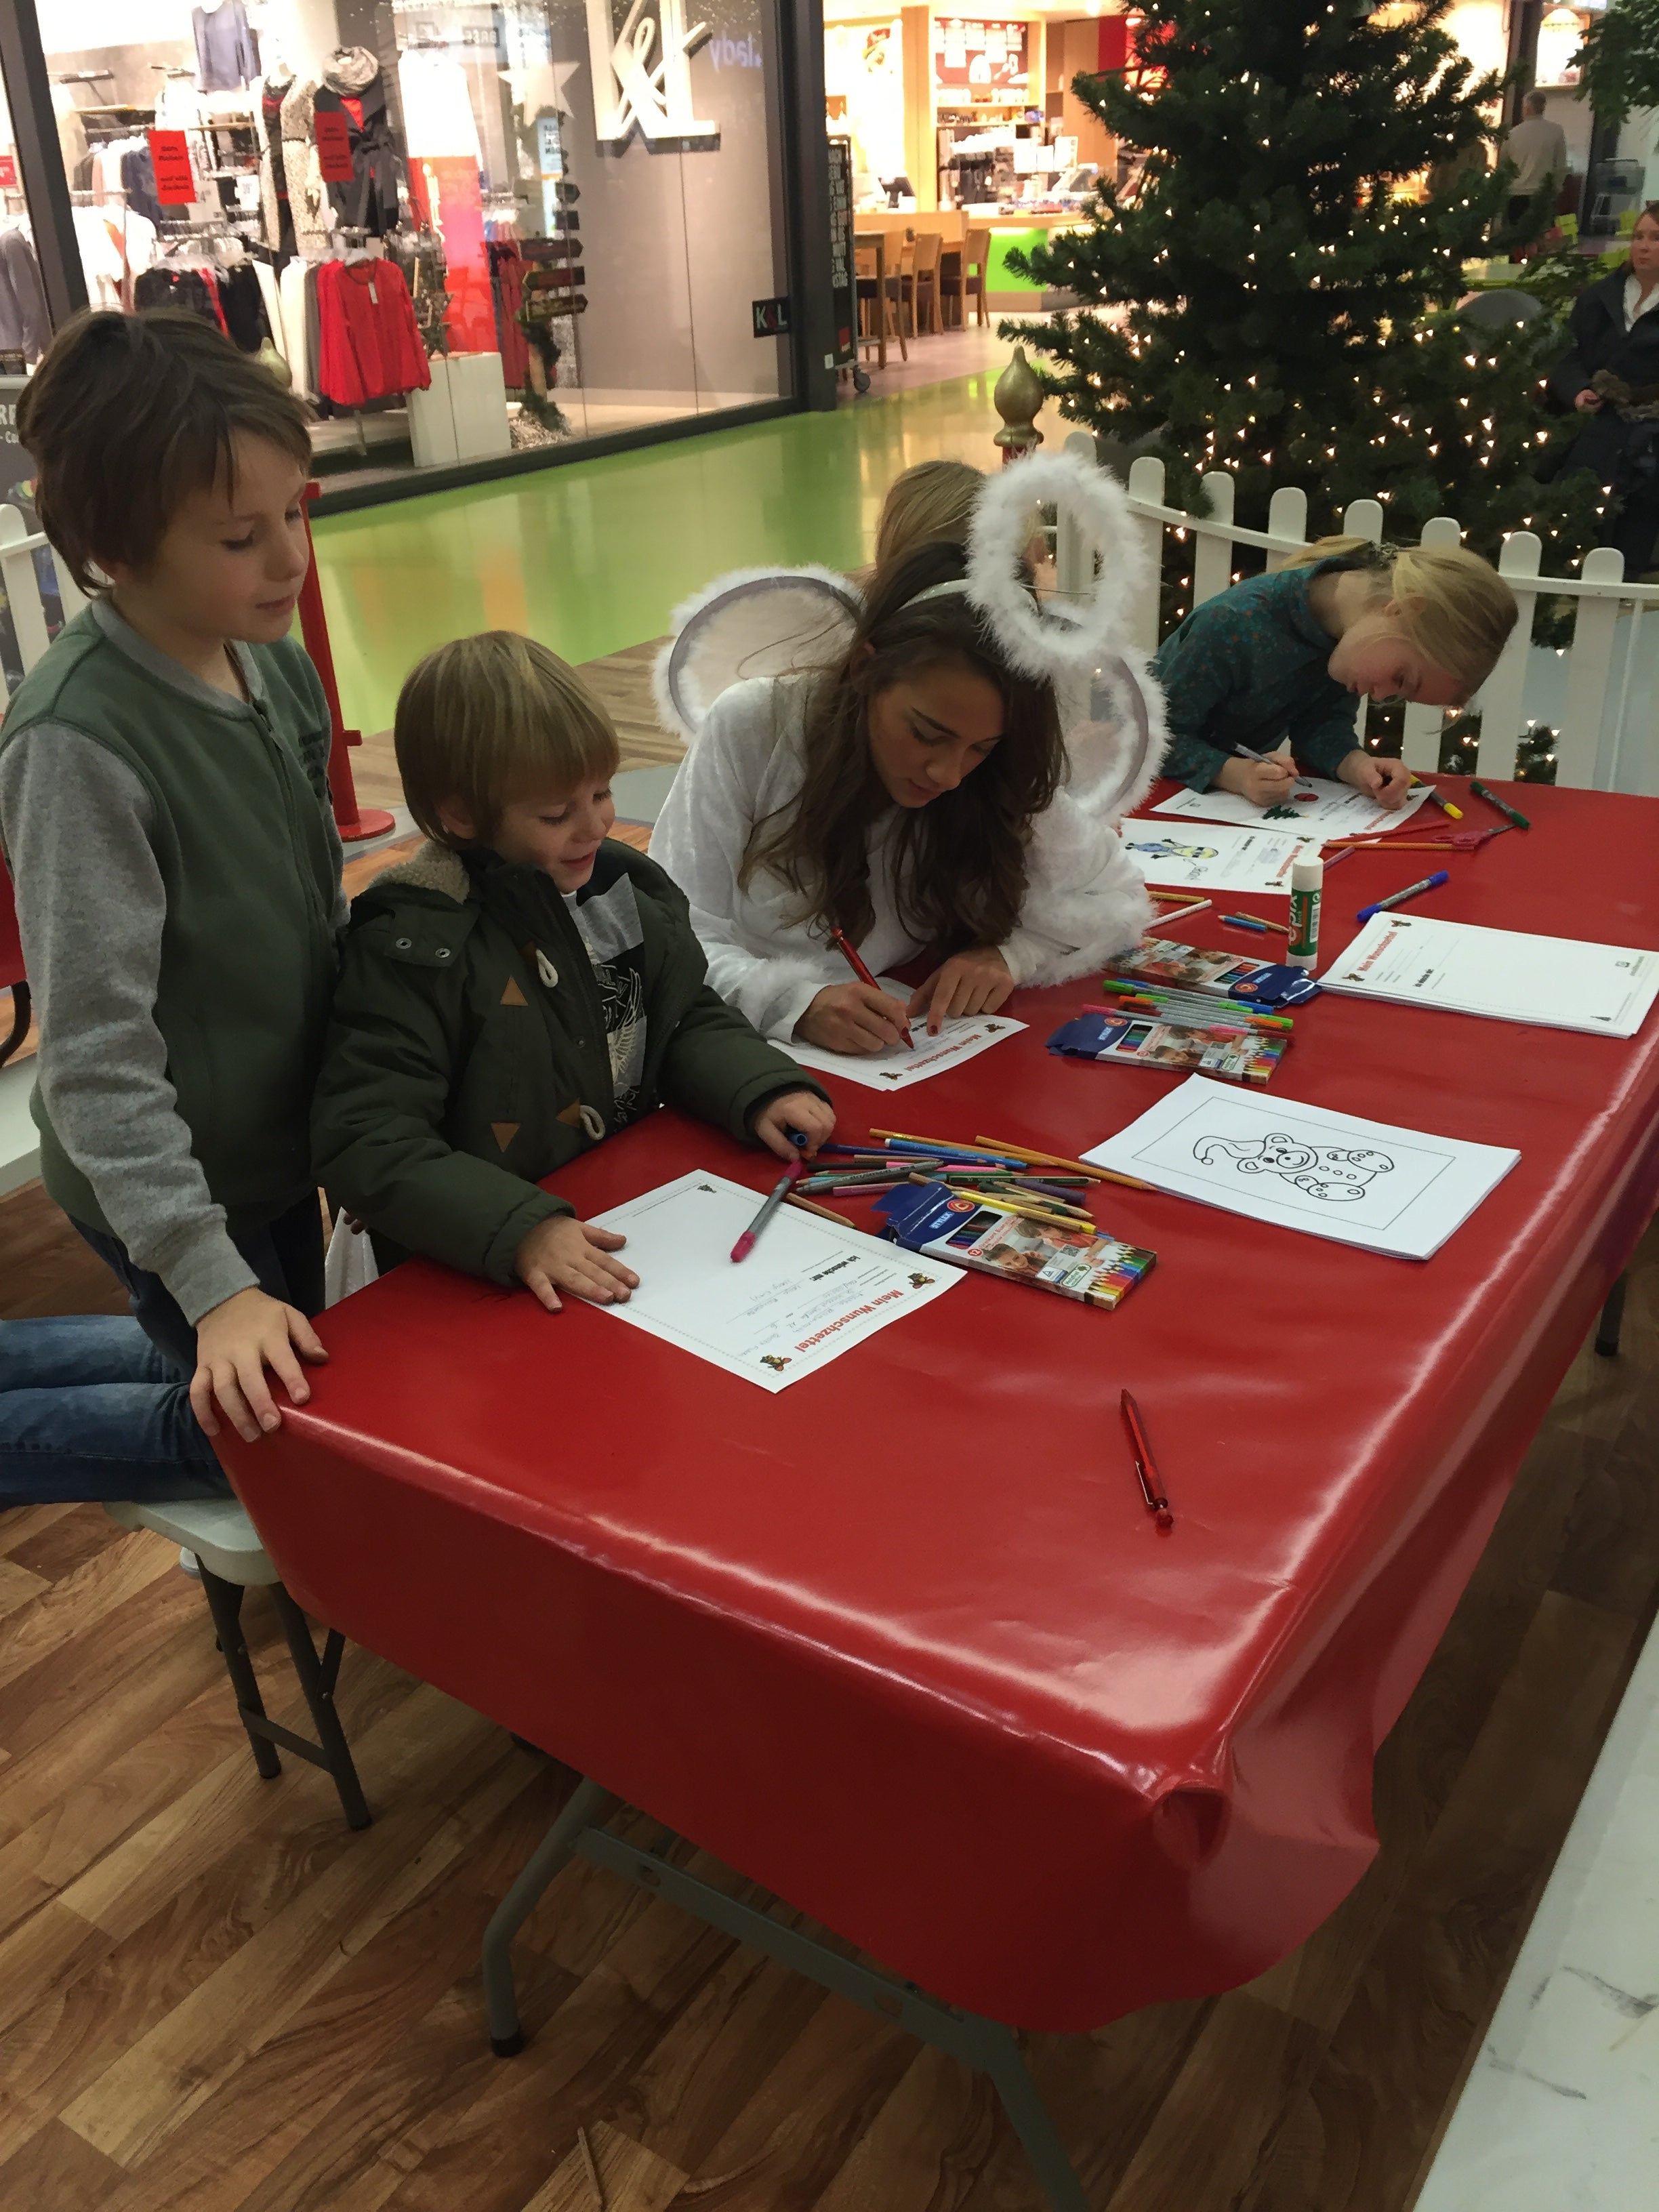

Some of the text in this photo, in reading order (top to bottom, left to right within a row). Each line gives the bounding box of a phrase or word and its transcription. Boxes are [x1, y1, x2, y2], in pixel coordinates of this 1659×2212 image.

[930, 1212, 954, 1229] STYLEX
[848, 1254, 861, 1263] Ich
[969, 1248, 981, 1256] 12
[821, 1261, 850, 1275] wünsche
[871, 1289, 904, 1307] Mein
[794, 1304, 877, 1353] Wunschzettel
